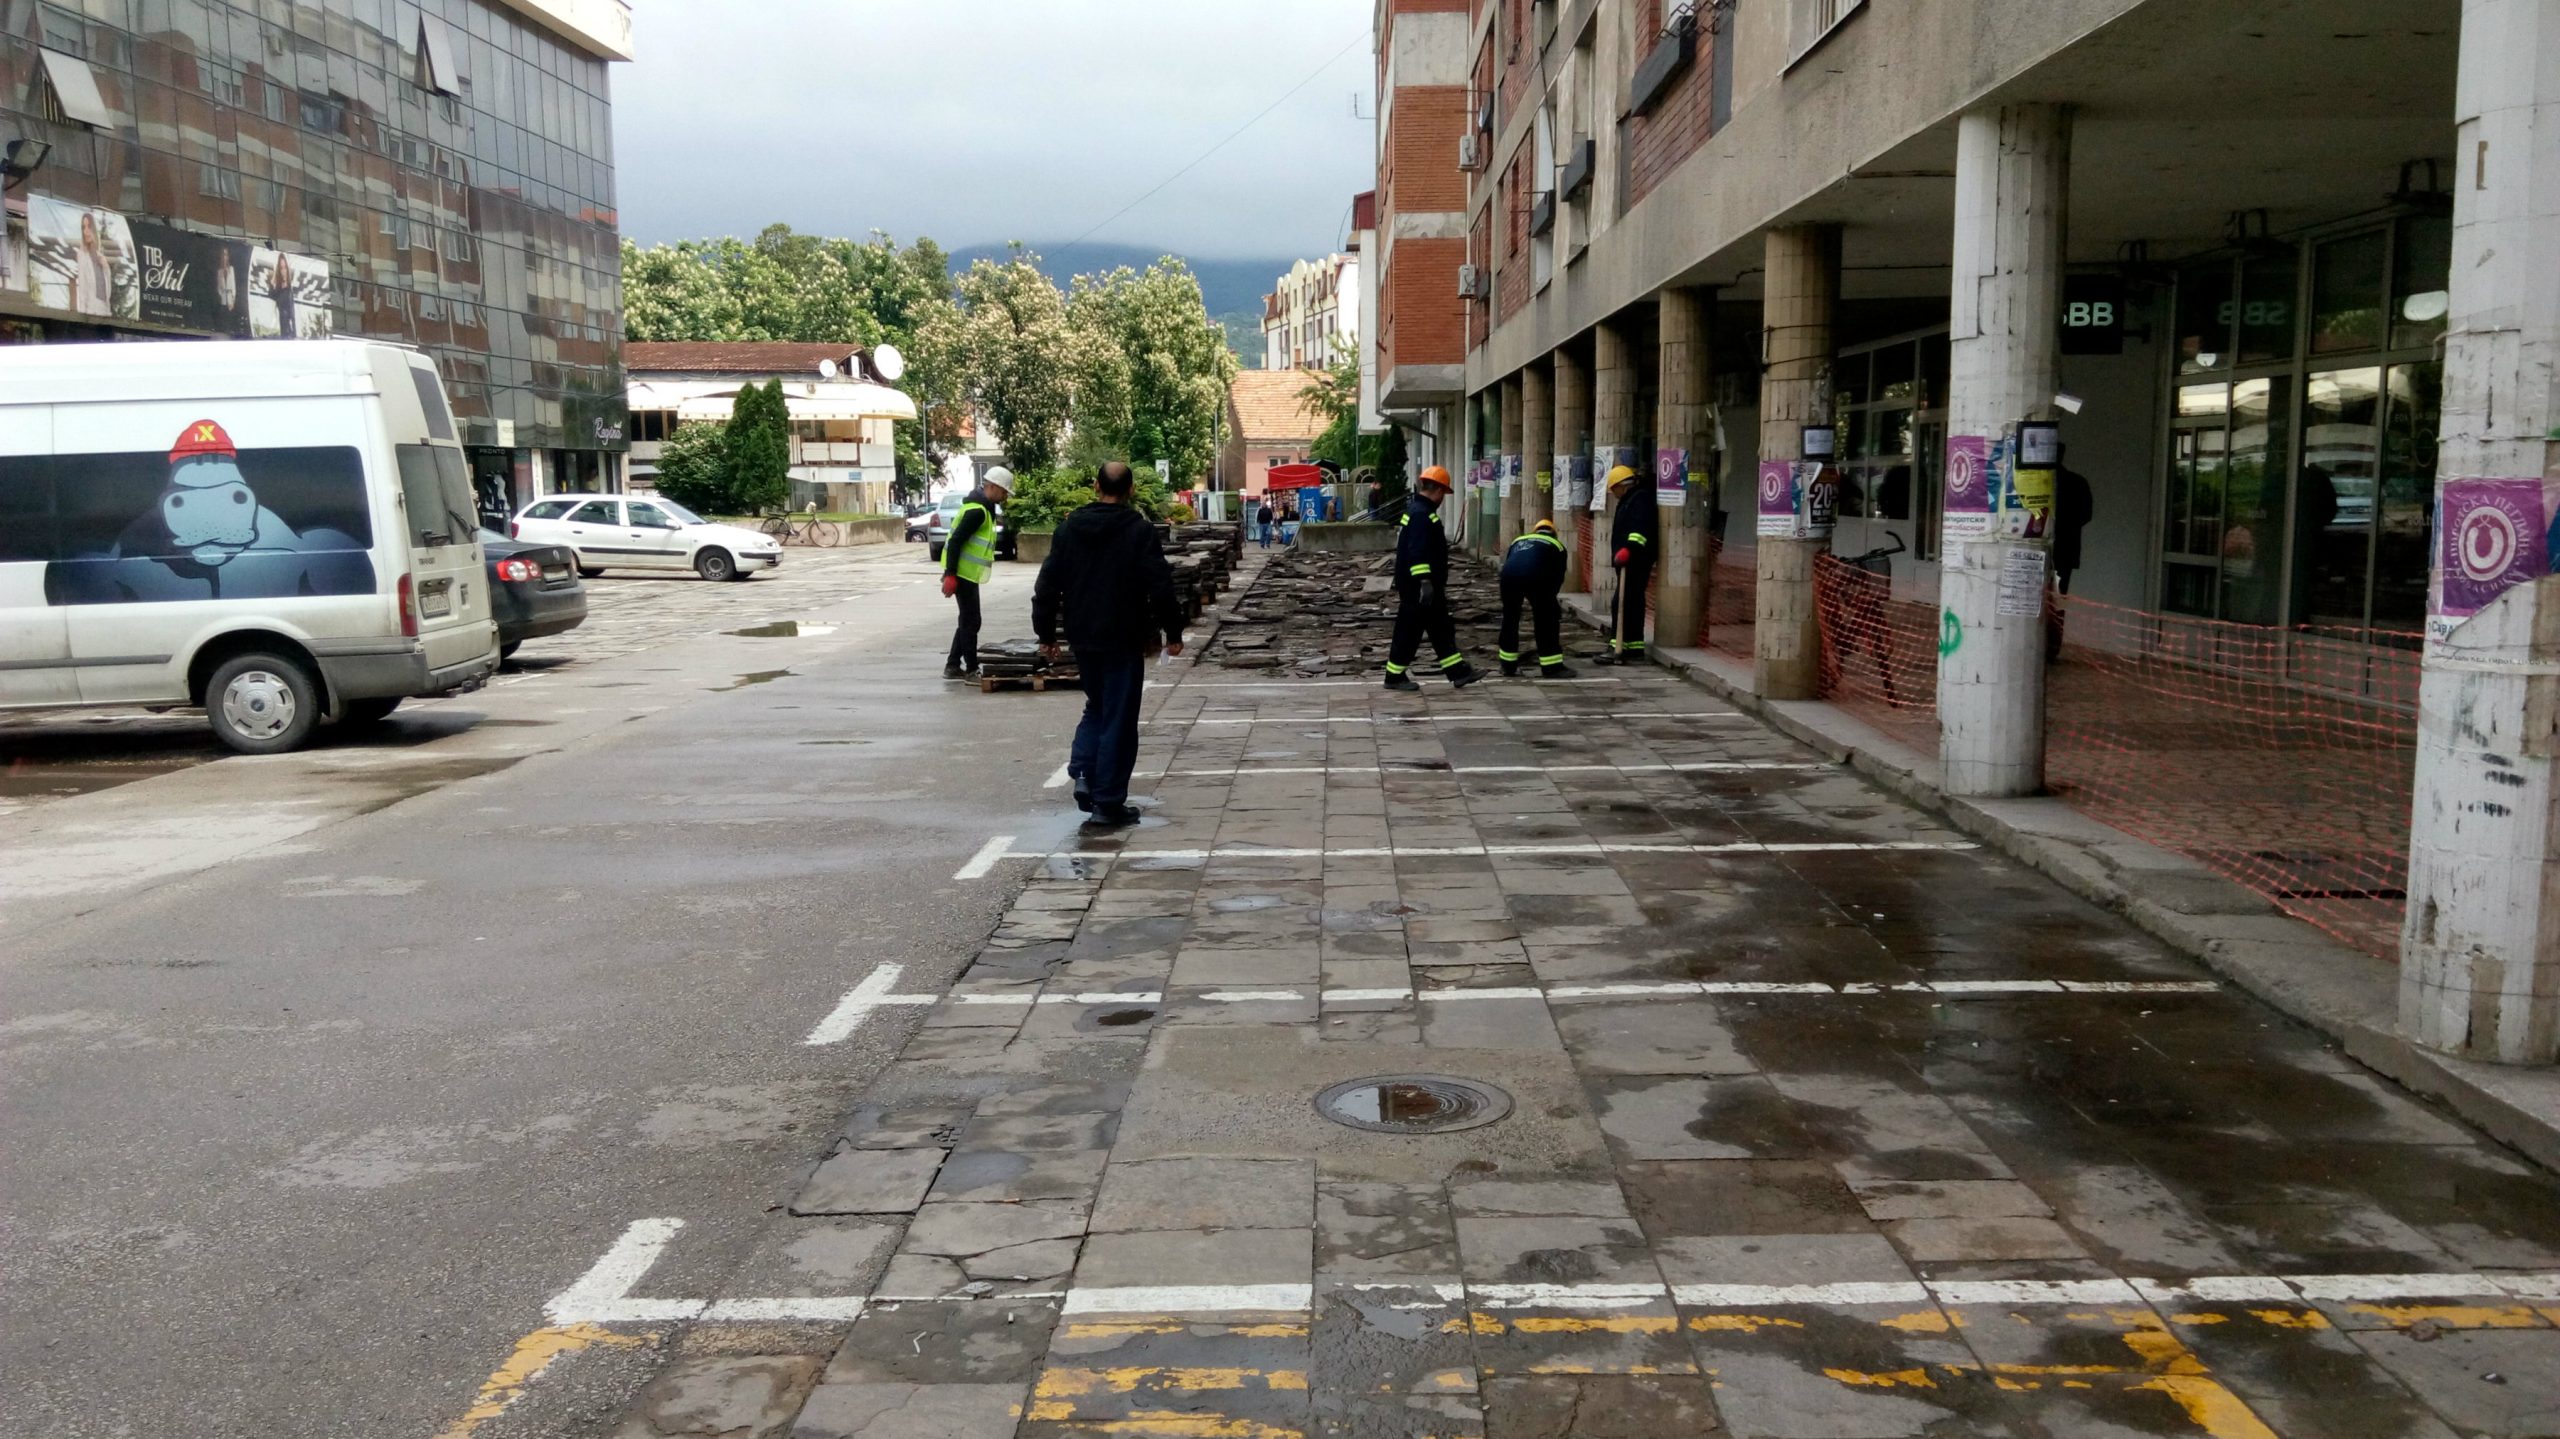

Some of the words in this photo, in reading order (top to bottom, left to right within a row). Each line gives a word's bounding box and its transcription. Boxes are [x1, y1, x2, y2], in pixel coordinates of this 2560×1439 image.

[143, 245, 163, 267] TIB
[145, 260, 189, 291] Stil
[2063, 302, 2114, 327] BB
